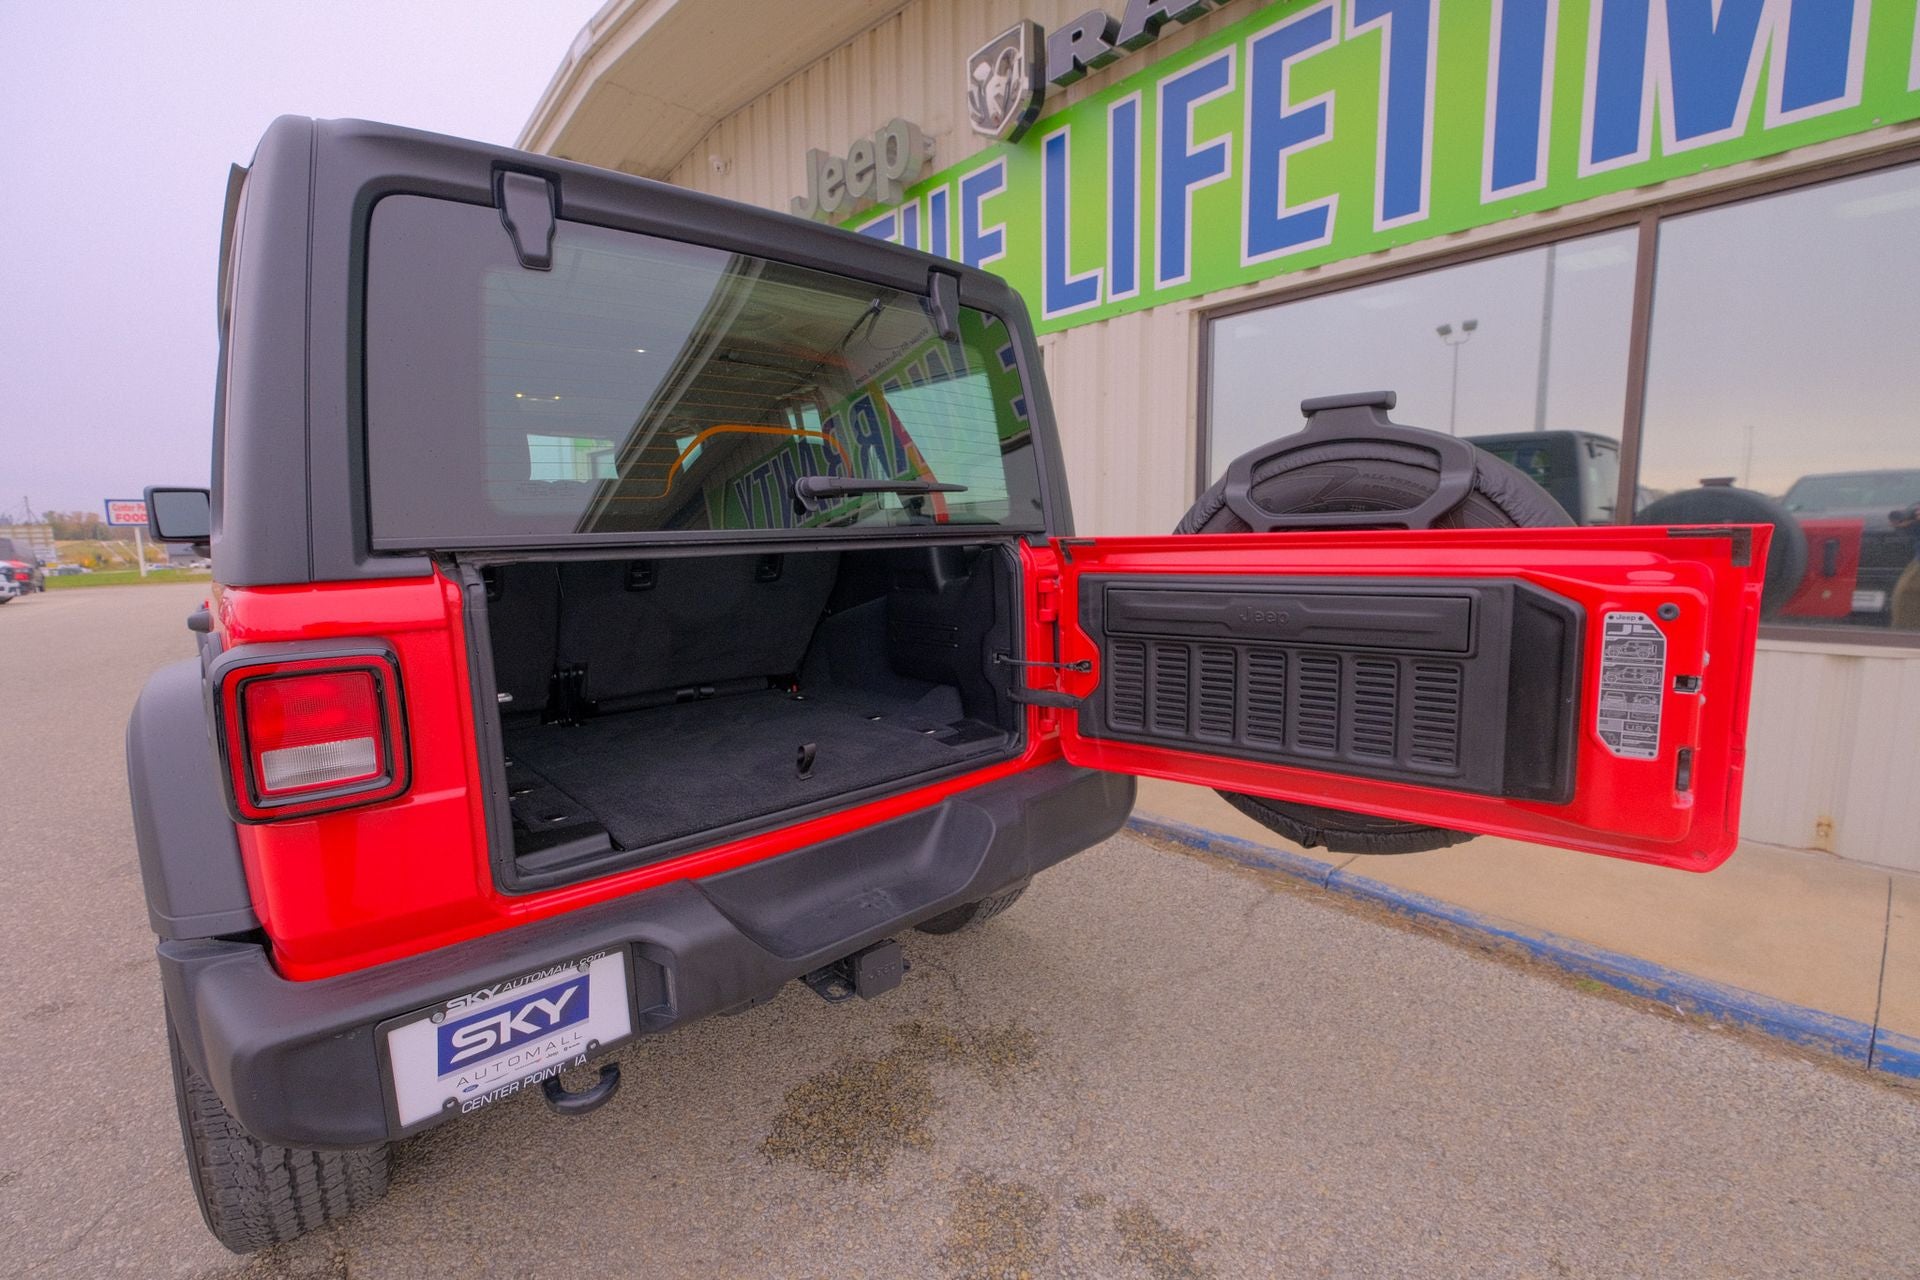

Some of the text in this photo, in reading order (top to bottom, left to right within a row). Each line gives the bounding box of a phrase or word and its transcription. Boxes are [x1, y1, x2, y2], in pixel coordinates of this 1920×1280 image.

[1047, 0, 1202, 82] RA
[791, 118, 912, 221] Jeep
[1041, 0, 1920, 321] LIFETIM
[1239, 605, 1289, 626] Jeep
[451, 985, 579, 1064] SKY
[456, 1032, 583, 1088] AUTOMALL
[462, 1081, 519, 1114] CENTER
[574, 1054, 587, 1067] IA
